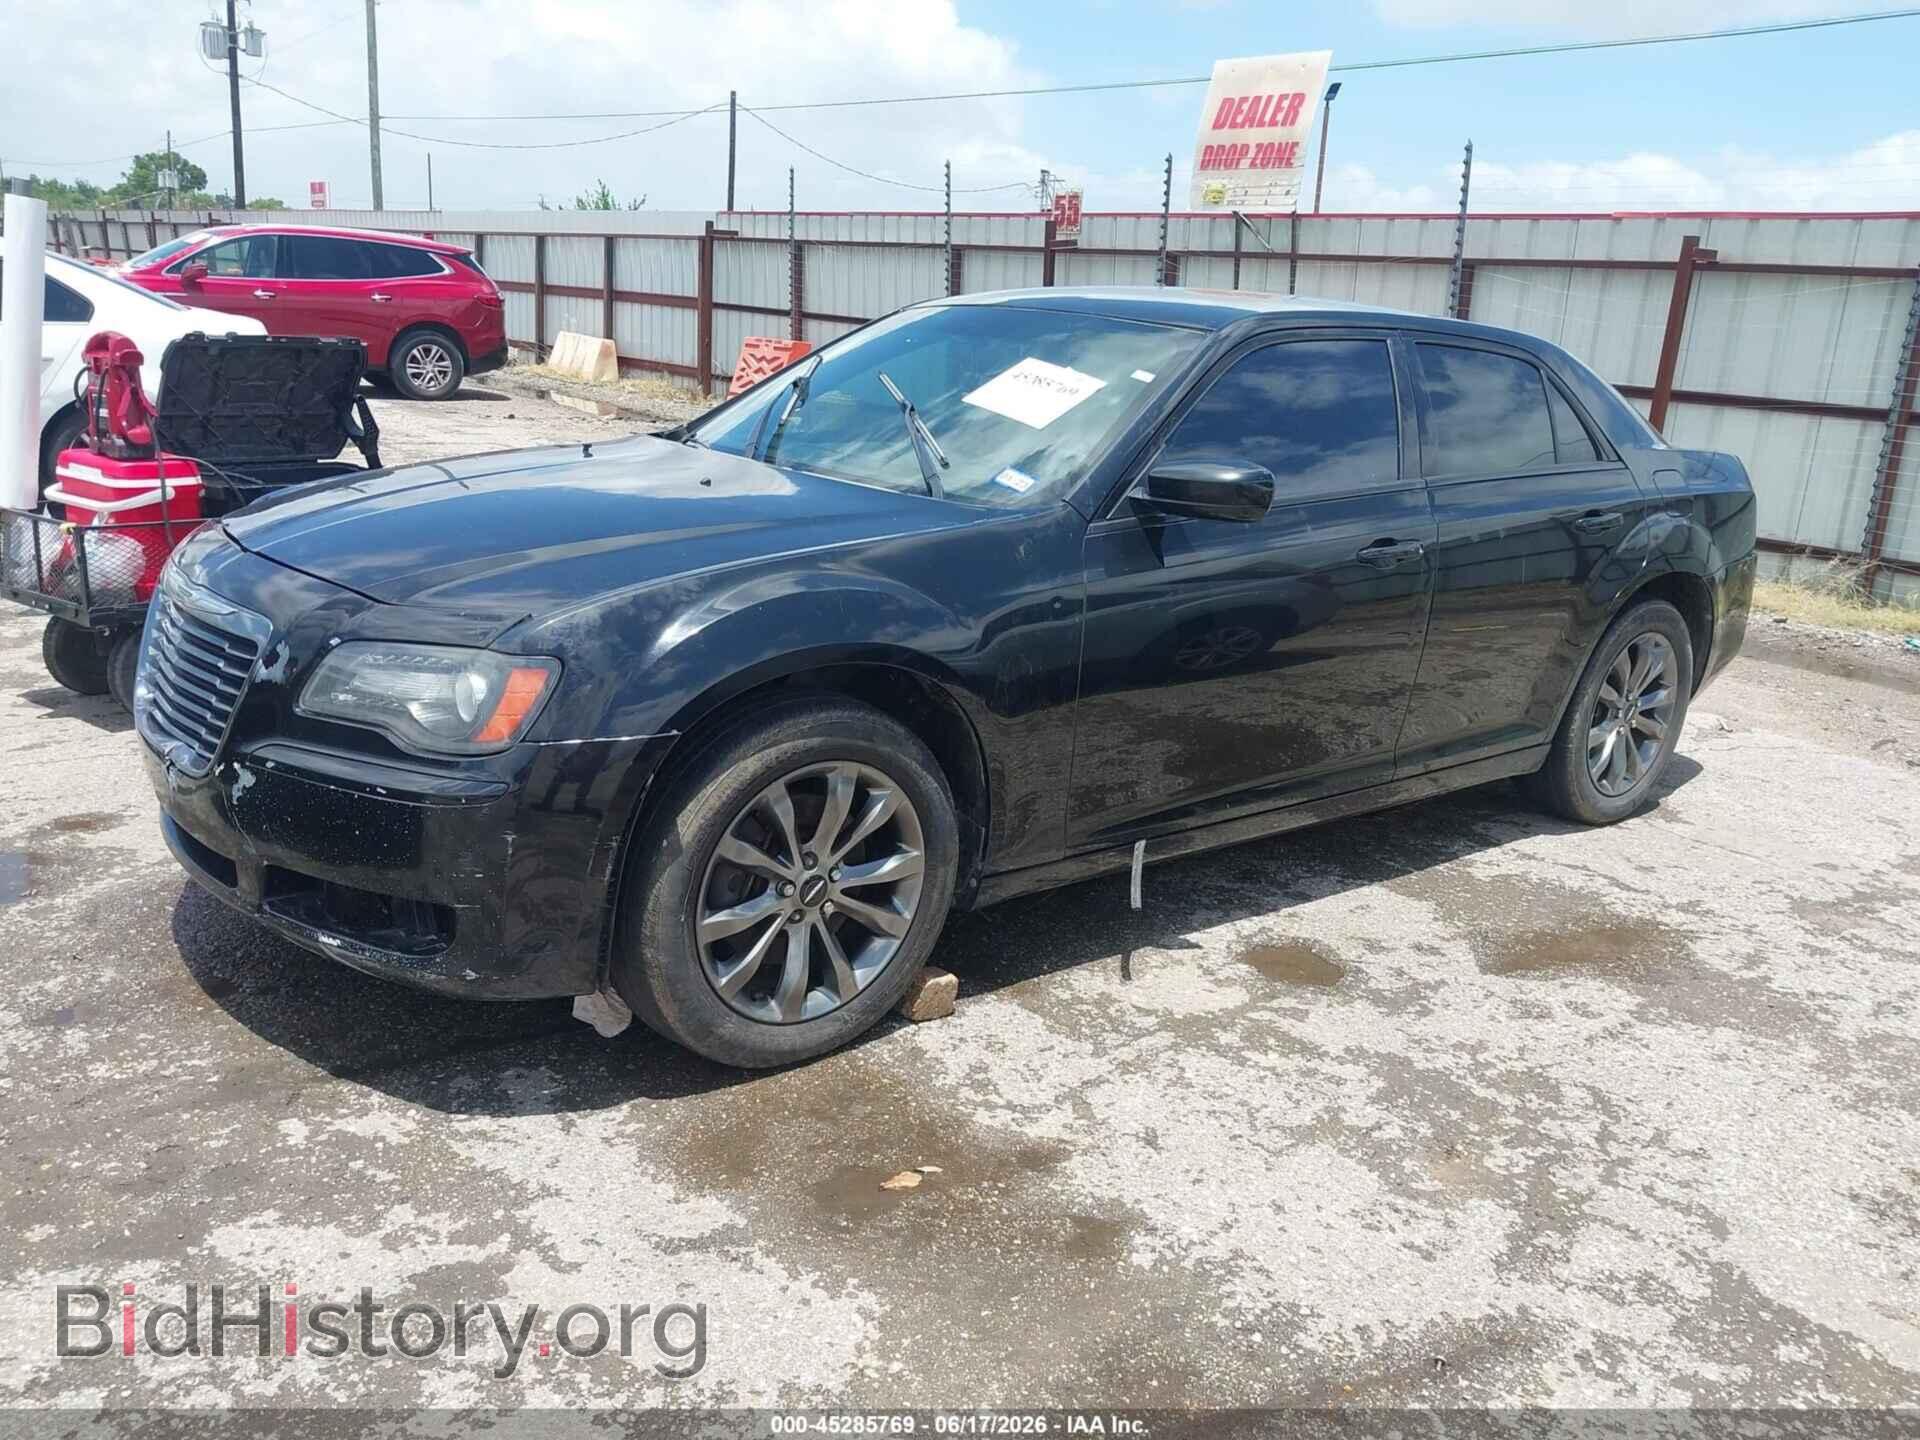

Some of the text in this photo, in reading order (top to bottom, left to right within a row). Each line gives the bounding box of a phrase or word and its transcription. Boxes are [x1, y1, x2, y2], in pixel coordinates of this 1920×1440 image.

[1212, 93, 1306, 130] DEALER
[1200, 141, 1299, 171] DROP ZONE
